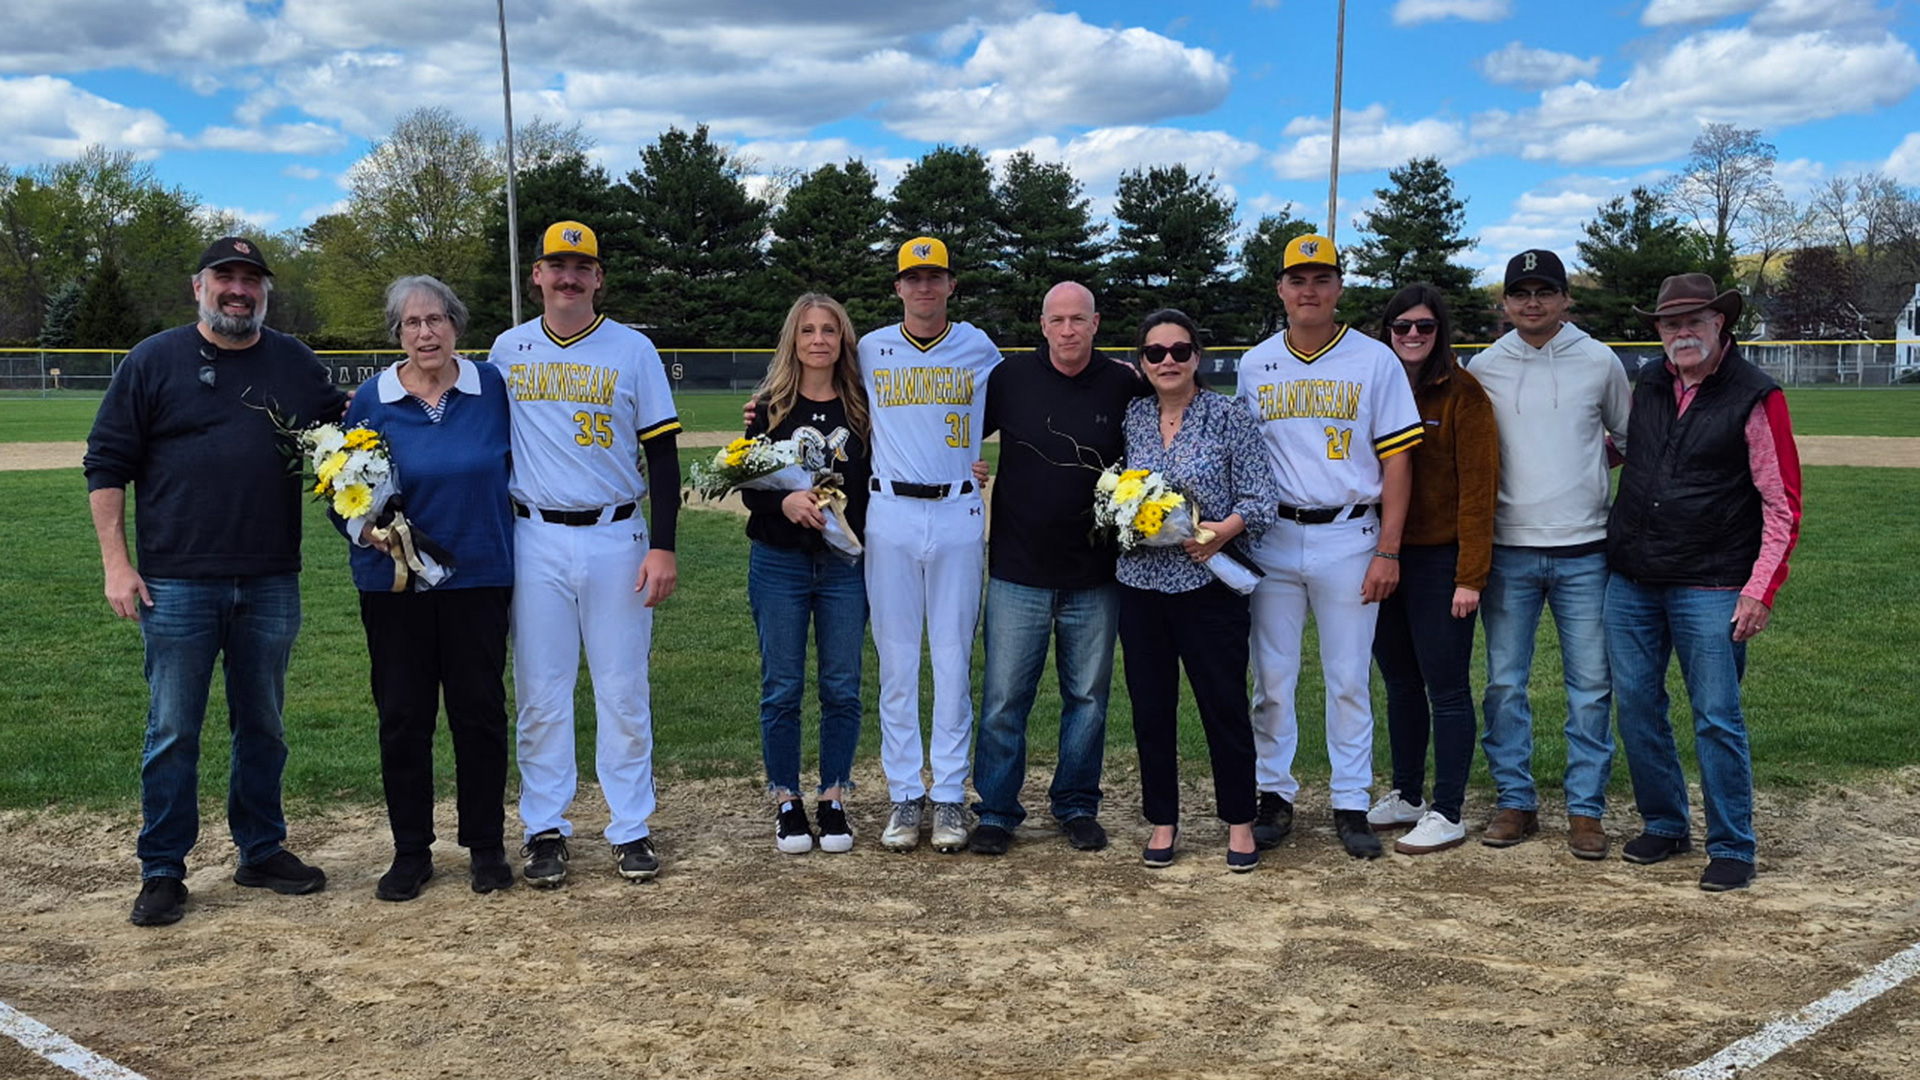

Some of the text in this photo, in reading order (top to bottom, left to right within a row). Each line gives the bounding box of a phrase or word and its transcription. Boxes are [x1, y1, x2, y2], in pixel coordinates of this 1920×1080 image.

[1522, 252, 1538, 272] B
[509, 362, 619, 407] FRAMINGHAM
[873, 365, 976, 408] FRAMINGHAM
[1258, 379, 1363, 422] FRAMINGHAM
[573, 410, 614, 449] 35
[945, 412, 971, 448] 31
[1324, 425, 1354, 461] 21
